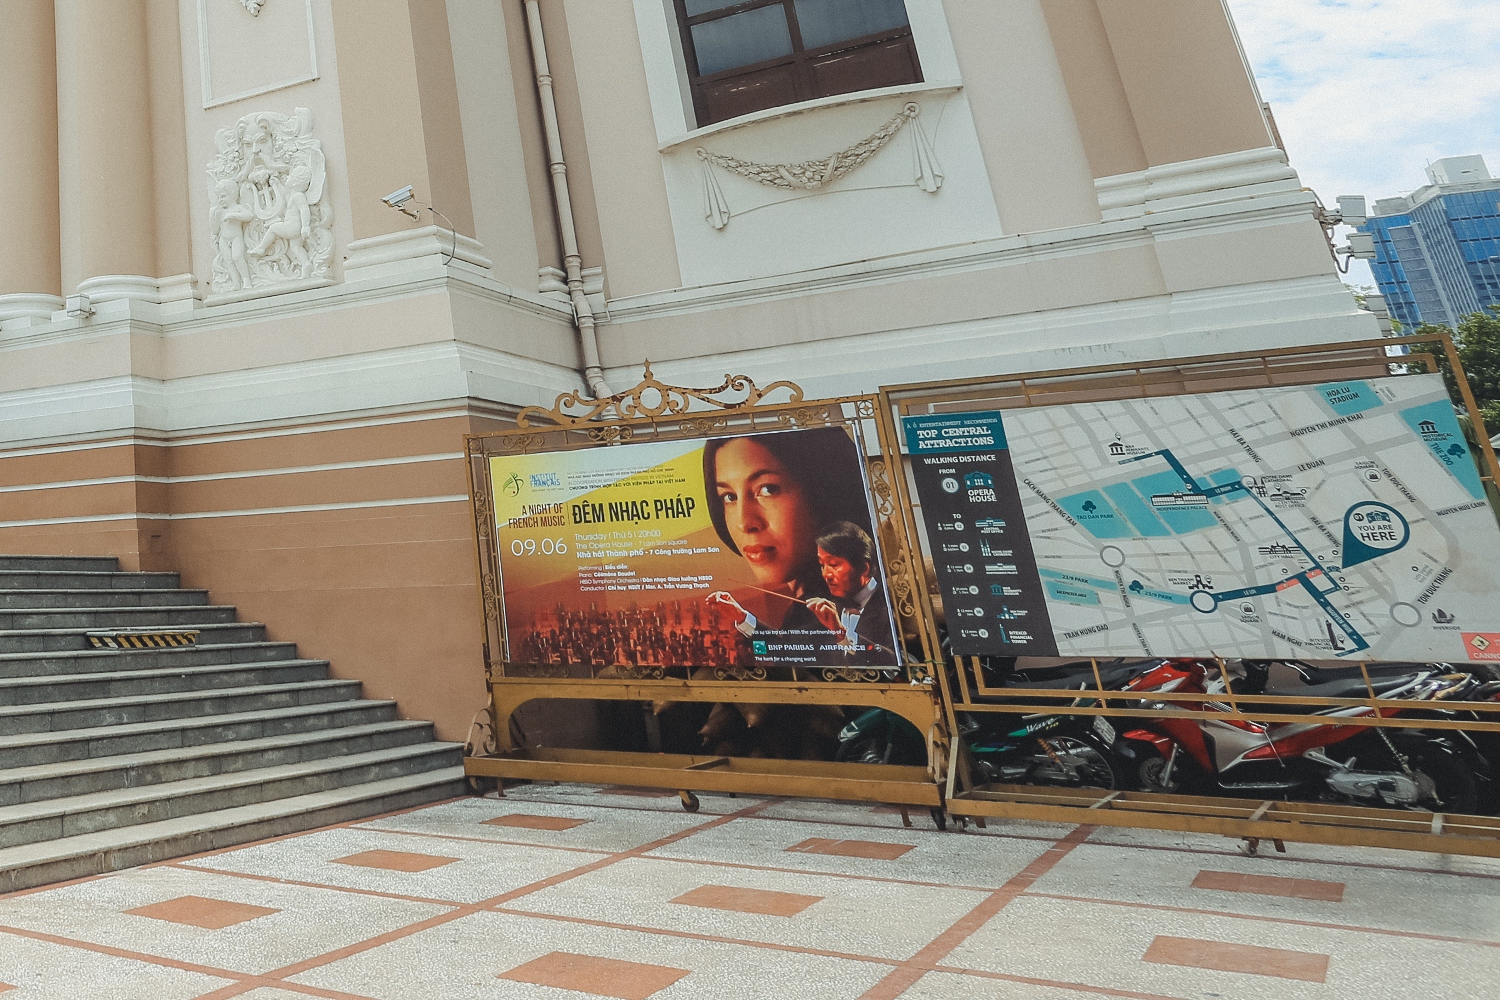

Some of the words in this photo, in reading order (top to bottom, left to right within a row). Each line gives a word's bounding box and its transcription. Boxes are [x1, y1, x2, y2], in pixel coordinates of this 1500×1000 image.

[1326, 388, 1339, 398] HOA
[1340, 386, 1350, 395] LU
[1329, 392, 1360, 405] STADIUM
[919, 420, 961, 428] ENTERTAINMENT
[1289, 425, 1317, 438] NGUYEN
[1315, 422, 1328, 432] THI
[1327, 417, 1347, 429] MINH
[1347, 412, 1364, 423] KHAI
[917, 429, 938, 438] TOP
[941, 426, 991, 437] CENTRAL
[919, 436, 994, 449] ATTRACTIONS
[1228, 428, 1238, 439] HAI
[1236, 438, 1246, 447] BA
[1244, 444, 1261, 463] TRUNG
[924, 456, 959, 465] WALKING
[959, 454, 996, 463] DISTANCE
[1430, 442, 1442, 455] THE
[1440, 452, 1454, 466] ZOO
[1297, 464, 1307, 472] LE
[1307, 459, 1325, 470] DUAN
[529, 472, 557, 480] INSTITUT
[945, 481, 955, 489] 01
[1381, 467, 1392, 479] TON
[1390, 477, 1402, 488] DUC
[1399, 485, 1417, 503] THANG
[968, 488, 995, 496] OPERA
[522, 504, 527, 515] A
[528, 503, 552, 516] NIGHT
[553, 502, 564, 514] OF
[572, 499, 605, 524] ĐÊM
[608, 500, 651, 525] NHẠC
[654, 493, 696, 520] PHÁP
[1023, 478, 1037, 492] CACH
[1035, 488, 1051, 504] MANG
[1049, 501, 1067, 518] THANG
[1065, 514, 1078, 527] TAM
[1436, 507, 1459, 517] NGUYEN
[1471, 501, 1487, 510] CANH
[508, 517, 539, 529] FRENCH
[540, 515, 566, 528] MUSIC
[574, 532, 607, 541] Thursday
[612, 530, 626, 539] Thứ
[627, 530, 633, 538] 5
[637, 529, 661, 538] 20h00
[1310, 516, 1320, 526] HAI
[1324, 530, 1341, 548] TRUNG
[1360, 531, 1398, 541] HERE
[511, 537, 568, 556] 09.06
[588, 541, 611, 550] Opera
[668, 539, 688, 547] square
[576, 550, 592, 559] Nhà
[592, 549, 605, 558] hát
[606, 549, 628, 557] Thành
[629, 547, 644, 558] phố
[672, 547, 693, 555] trường
[1074, 576, 1089, 584] PARK
[1417, 592, 1429, 605] TON
[1425, 582, 1440, 597] DUC
[1433, 566, 1453, 586] THANG
[1063, 628, 1080, 640] TRAN
[1079, 626, 1097, 636] HUNG
[1097, 623, 1109, 632] DAO
[1271, 629, 1287, 640] HAM
[1286, 636, 1303, 647] NGHI
[1025, 717, 1057, 733] Wave
